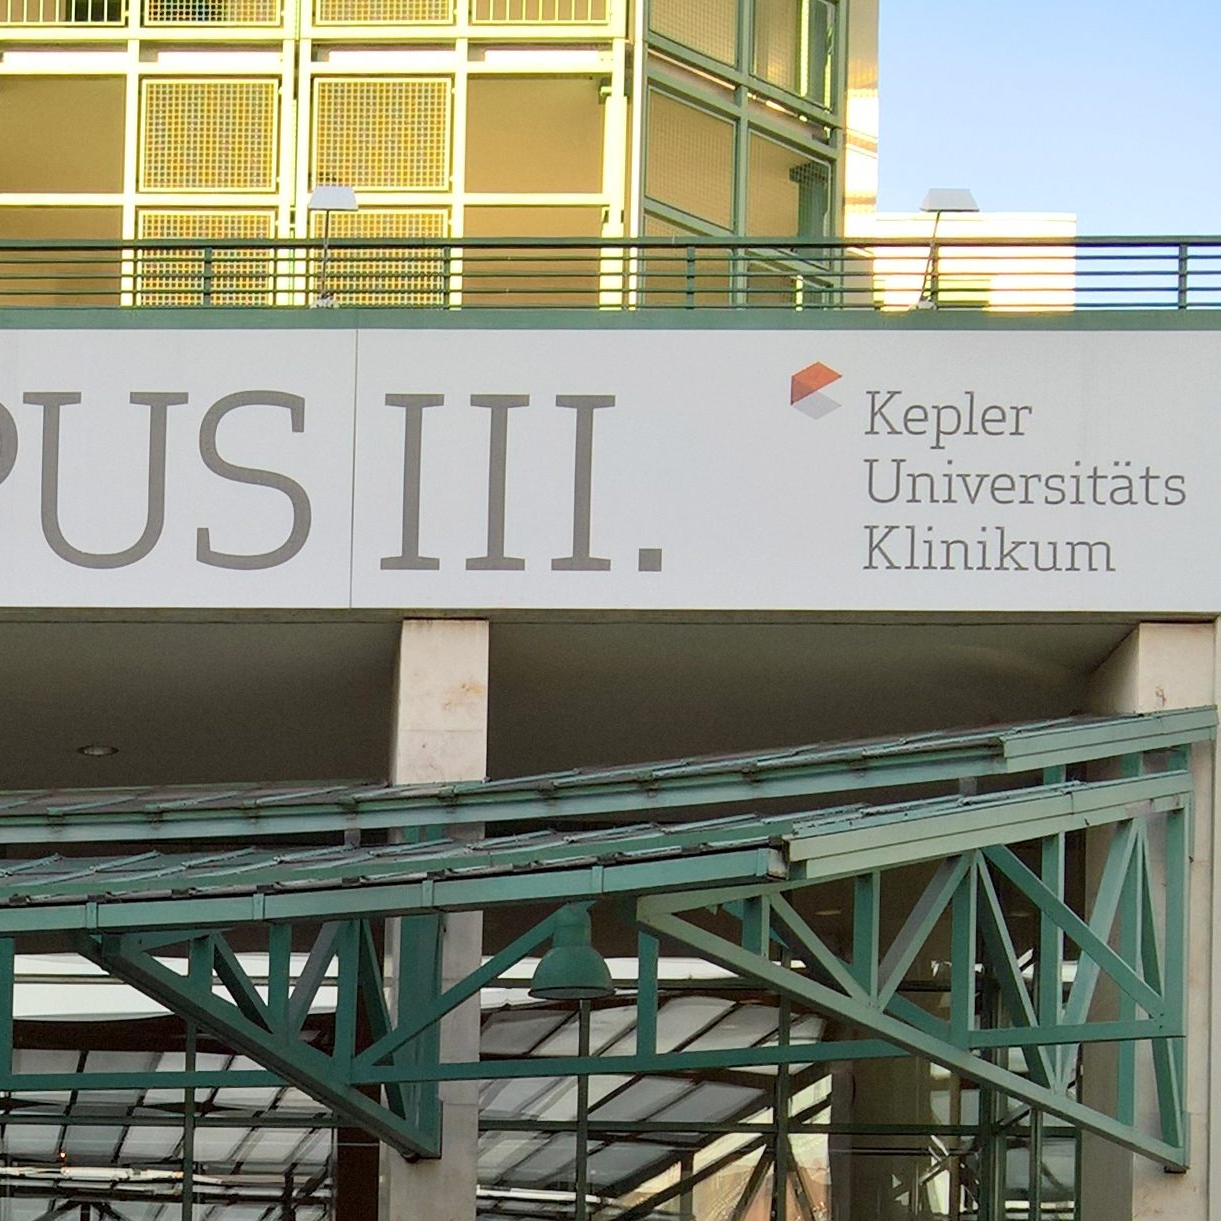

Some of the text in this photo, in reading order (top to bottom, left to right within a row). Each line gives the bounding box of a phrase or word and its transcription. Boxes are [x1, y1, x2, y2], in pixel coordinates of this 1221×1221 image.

[864, 390, 1033, 450] Kepler
[380, 393, 663, 571] III.
[863, 458, 1187, 506] Universitäts
[862, 525, 1117, 572] Klinikum
